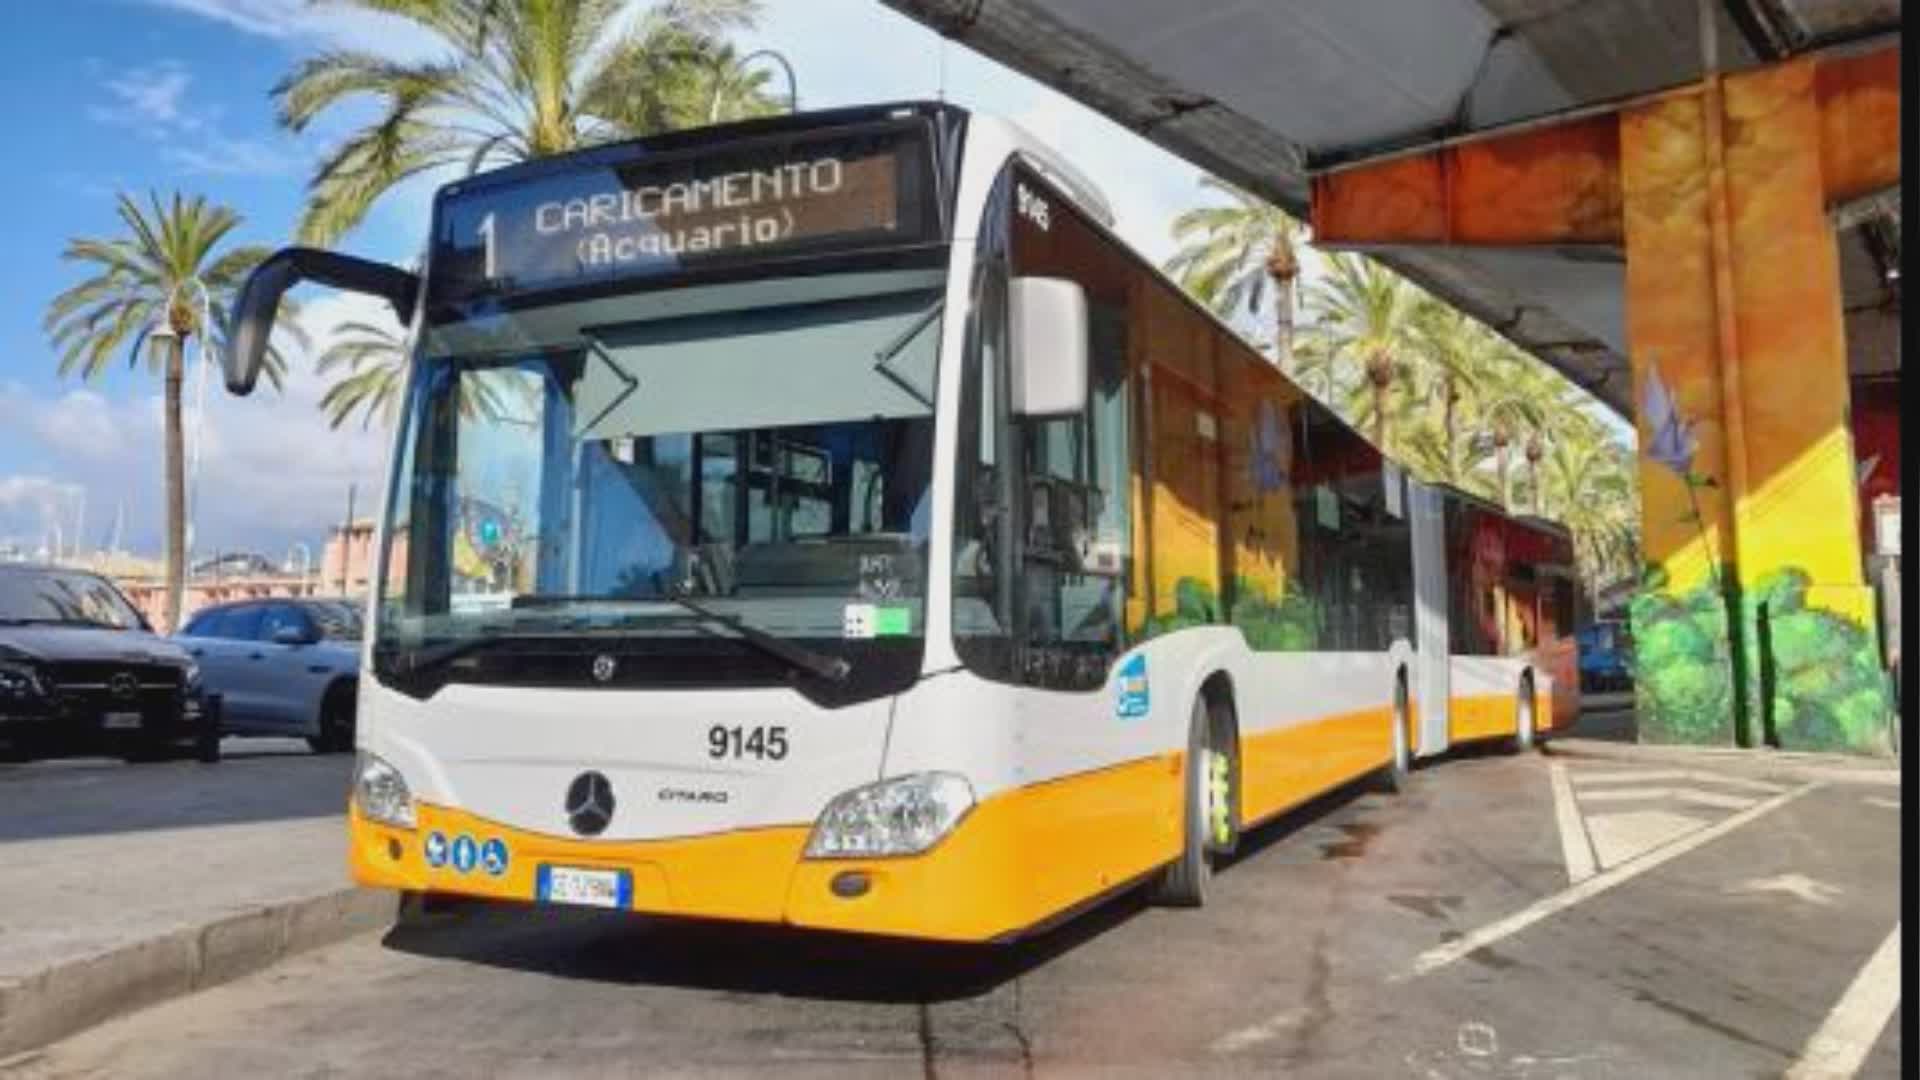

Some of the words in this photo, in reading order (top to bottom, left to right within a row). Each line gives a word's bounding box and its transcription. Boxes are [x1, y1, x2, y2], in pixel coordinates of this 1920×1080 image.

[535, 157, 842, 234] CARICAMENTO
[477, 212, 497, 280] 1
[577, 211, 795, 266] (Acquario)
[708, 725, 789, 760] 9145
